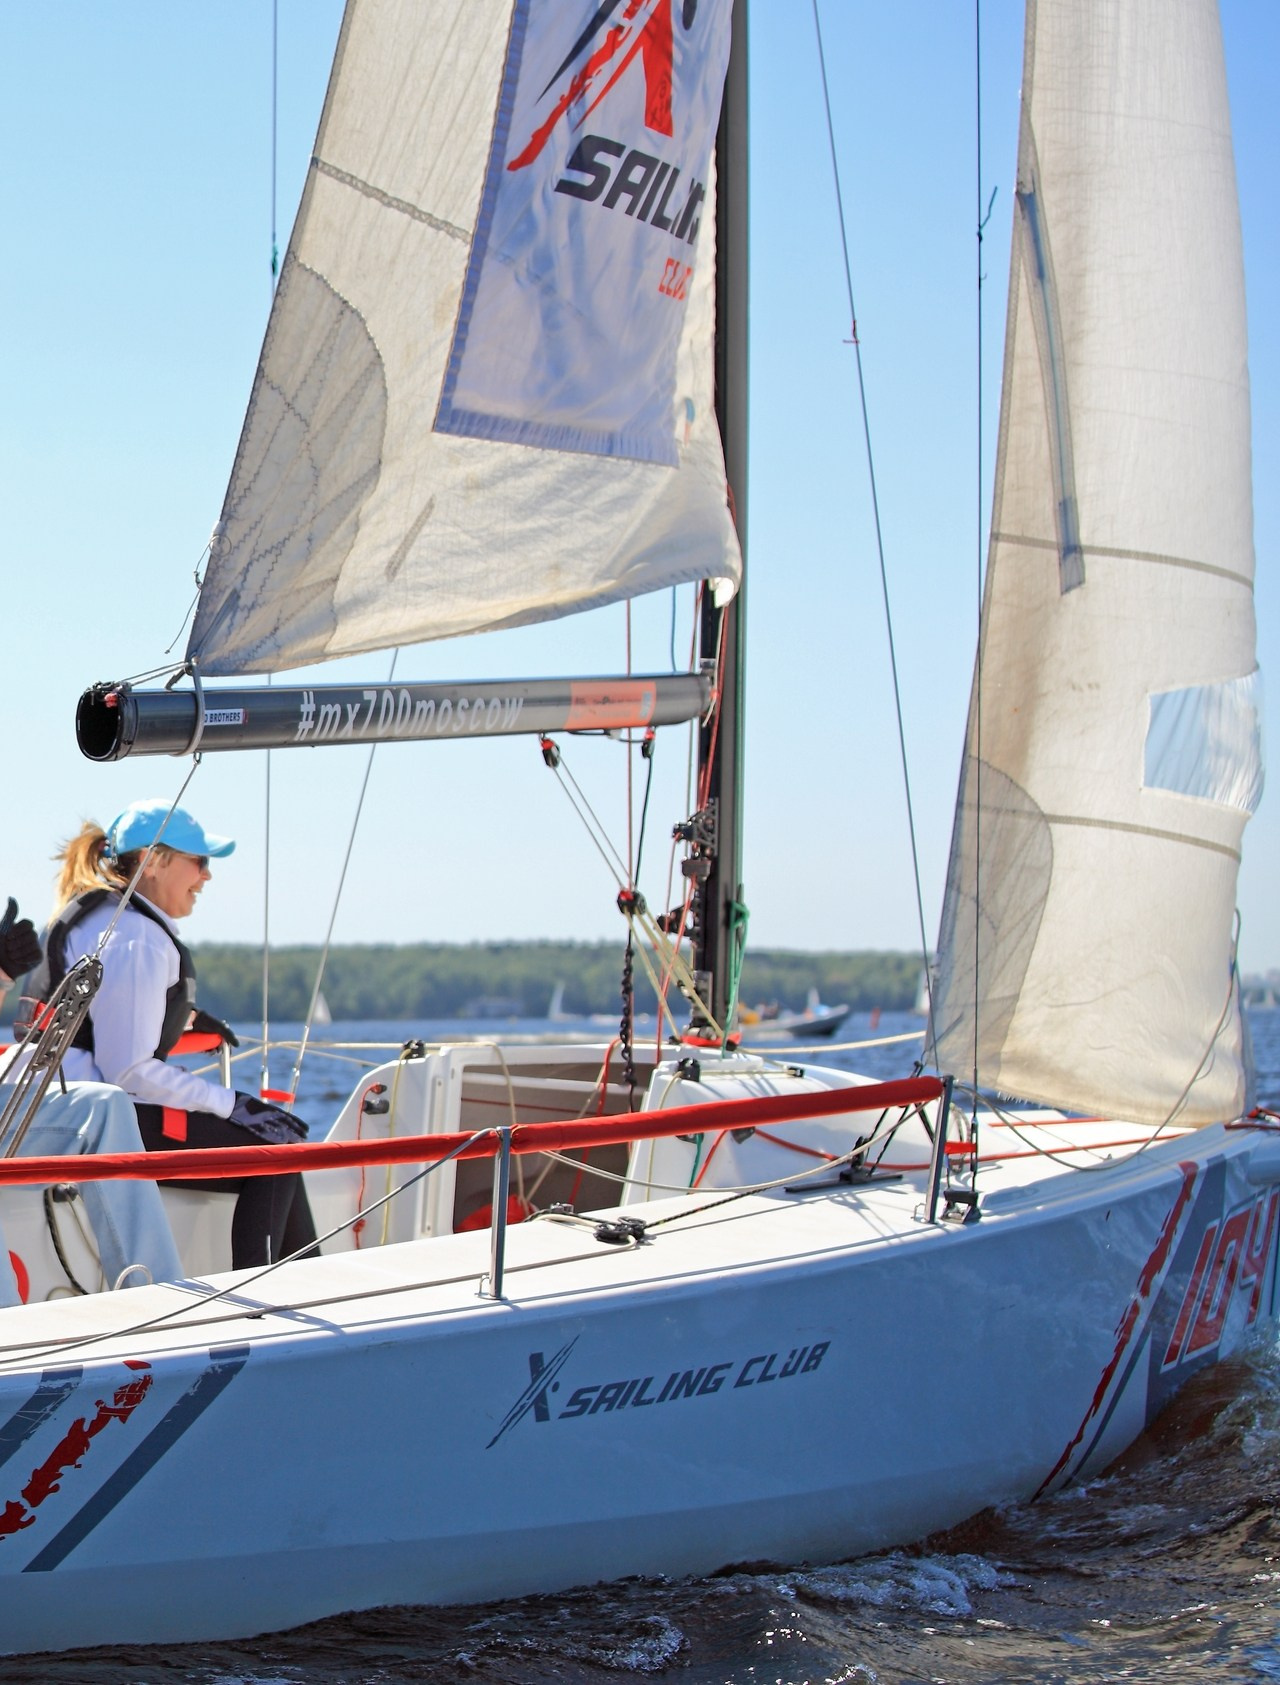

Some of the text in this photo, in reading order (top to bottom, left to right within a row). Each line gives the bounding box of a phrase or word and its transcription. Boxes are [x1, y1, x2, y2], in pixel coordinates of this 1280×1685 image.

[209, 711, 241, 723] BROTHERS
[294, 688, 524, 742] #mx700moscow
[557, 1361, 735, 1420] SAILING
[733, 1340, 832, 1389] CLUB
